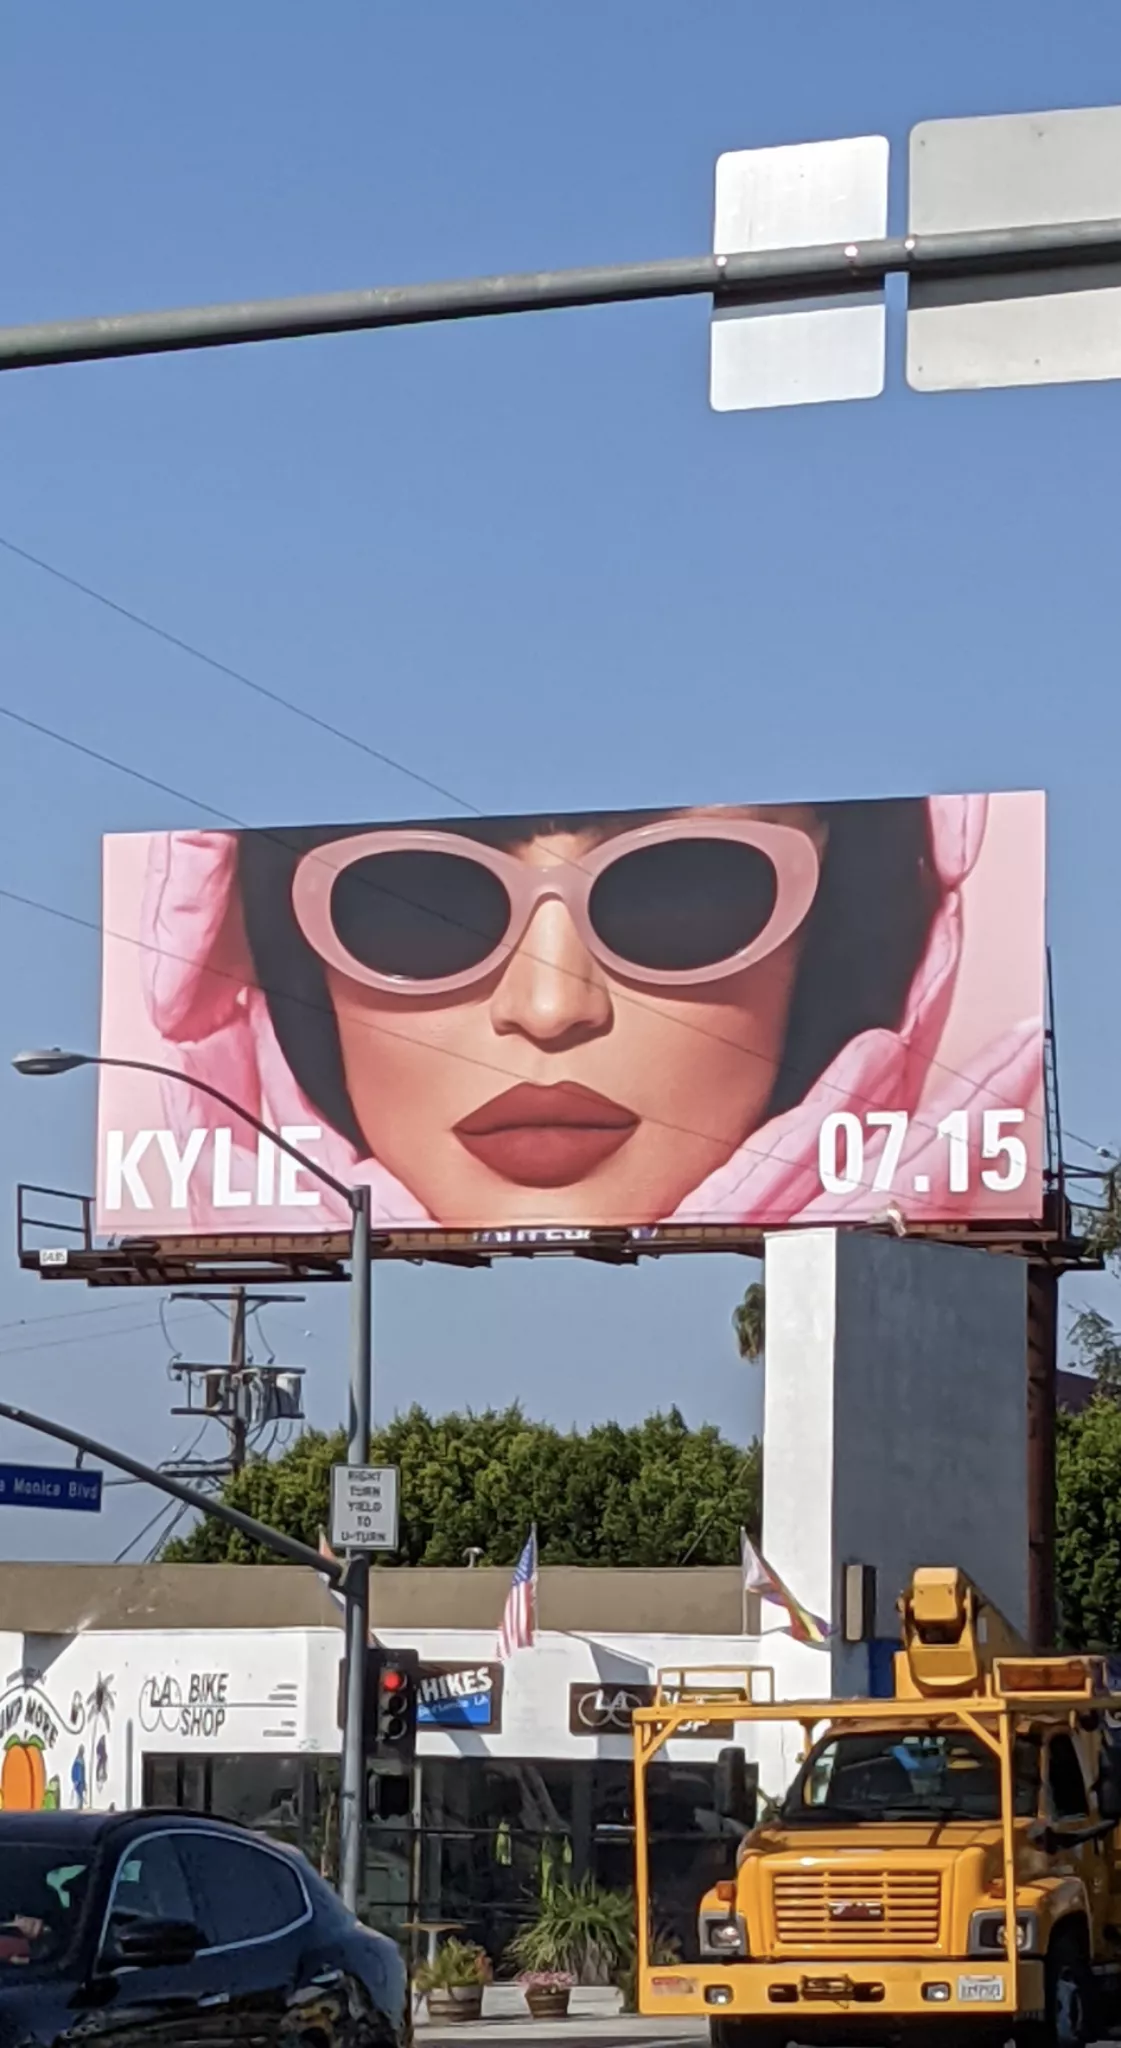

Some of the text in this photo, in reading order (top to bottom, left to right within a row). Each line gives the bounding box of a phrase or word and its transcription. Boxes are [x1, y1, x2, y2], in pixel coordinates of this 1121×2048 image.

[819, 1108, 1027, 1194] 07.15
[105, 1125, 321, 1210] KYLIE
[347, 1470, 382, 1482] RIGHT
[13, 1477, 61, 1497] Monica
[68, 1481, 99, 1500] Blvd
[350, 1485, 381, 1497] TURN
[347, 1501, 383, 1513] YIELD
[357, 1515, 372, 1528] TO
[341, 1530, 387, 1543] U-TURN
[150, 1673, 230, 1707] LA BIKE
[594, 1688, 632, 1711] LA
[24, 1695, 59, 1749] MORE
[179, 1707, 226, 1737] SHOP
